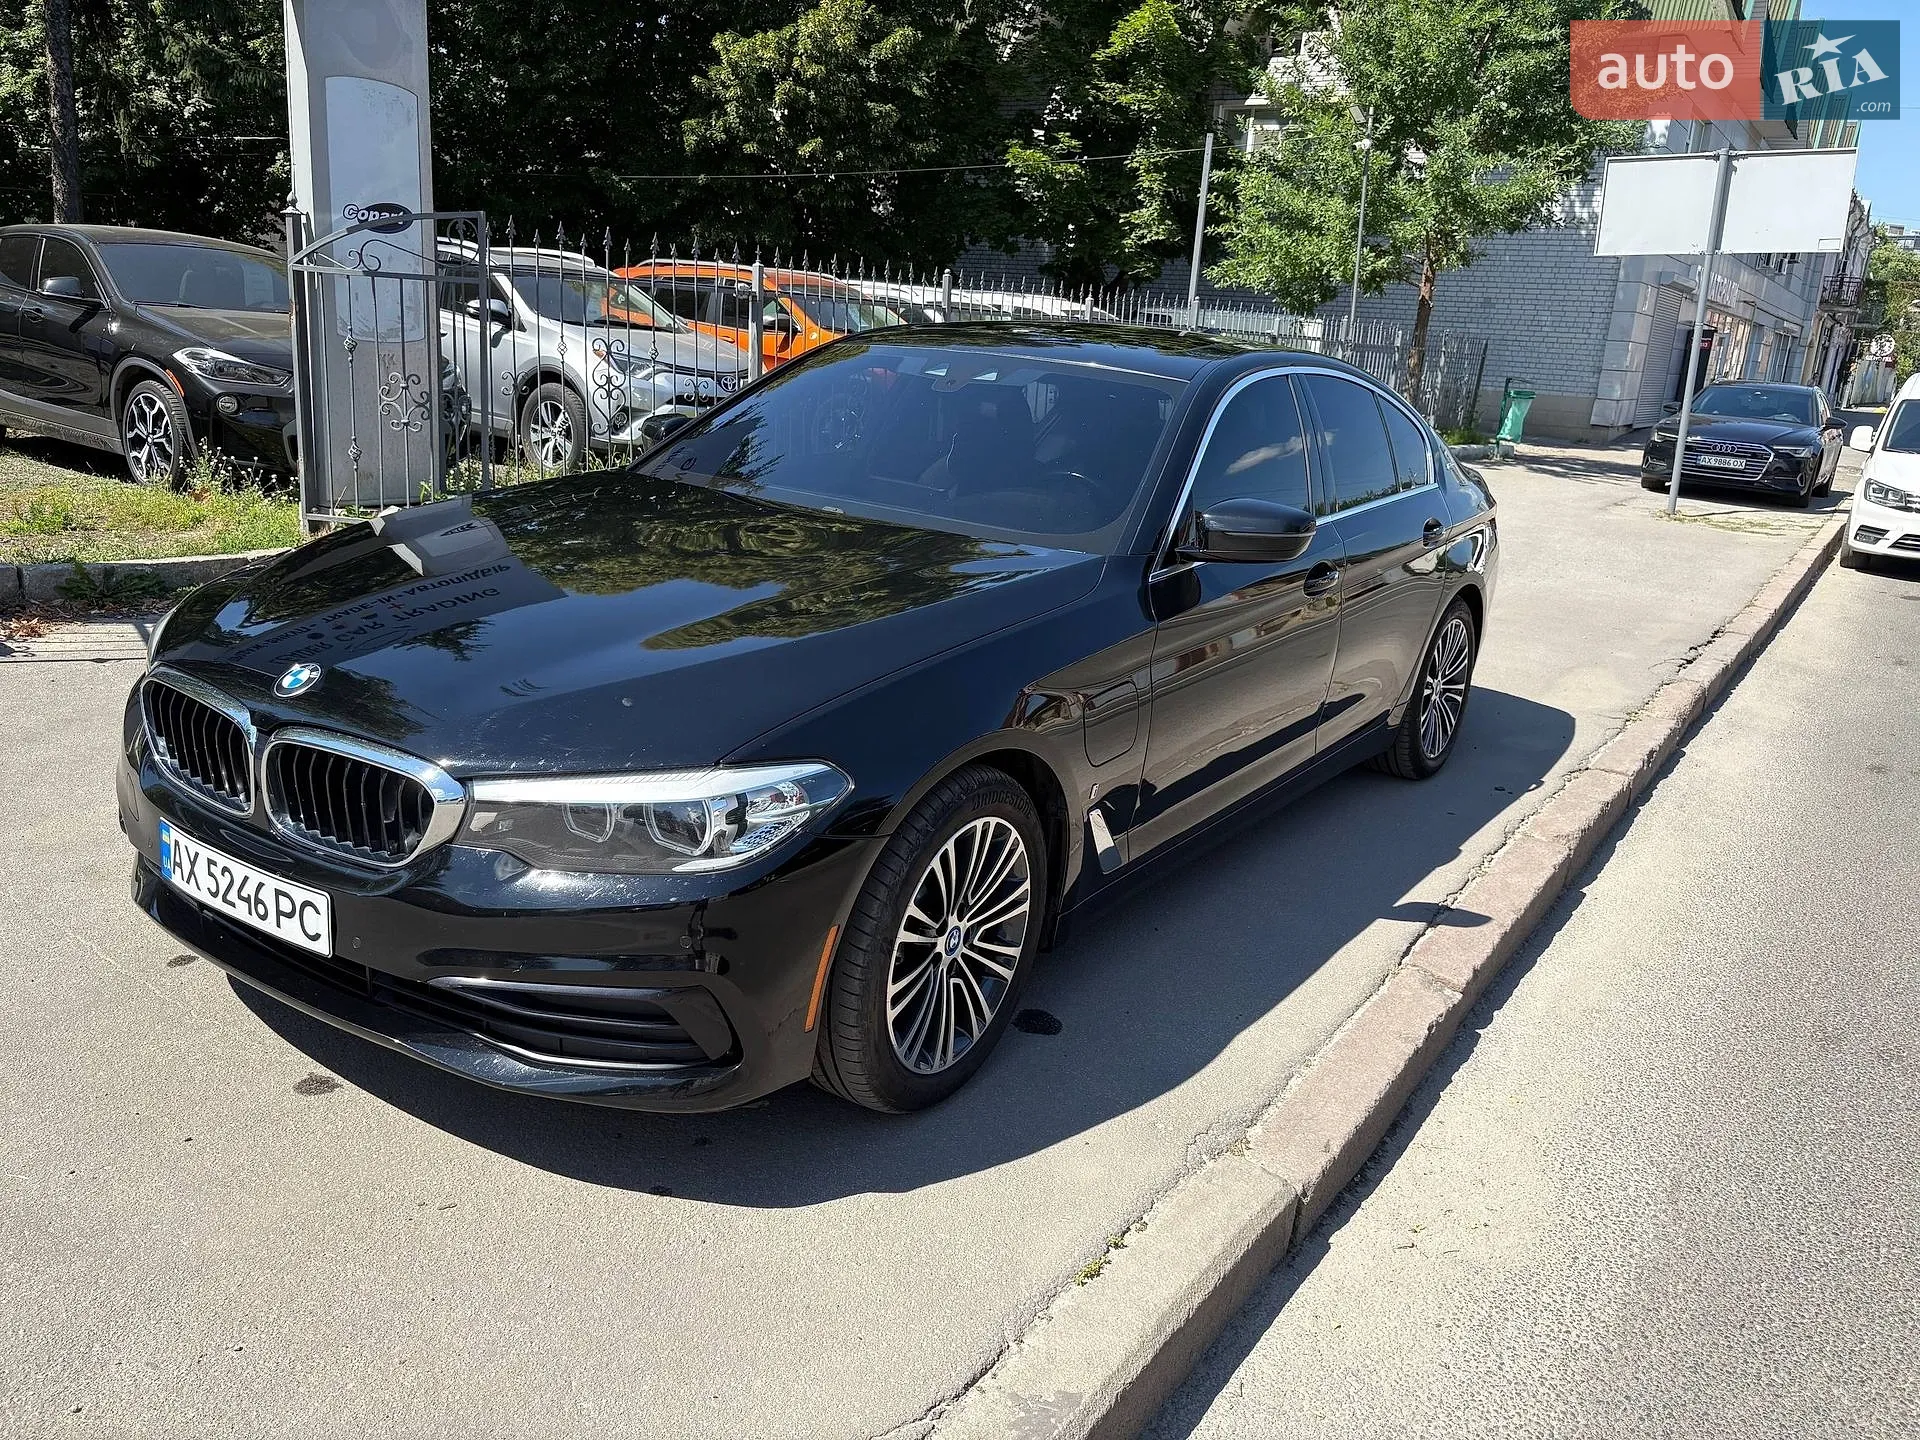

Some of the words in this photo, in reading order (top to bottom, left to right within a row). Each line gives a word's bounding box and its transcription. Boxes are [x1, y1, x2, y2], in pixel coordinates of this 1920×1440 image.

[1700, 456, 1713, 465] AX
[1713, 457, 1731, 467] 9886
[172, 838, 202, 892] AX
[206, 856, 269, 922] 5246
[275, 887, 322, 942] PC
